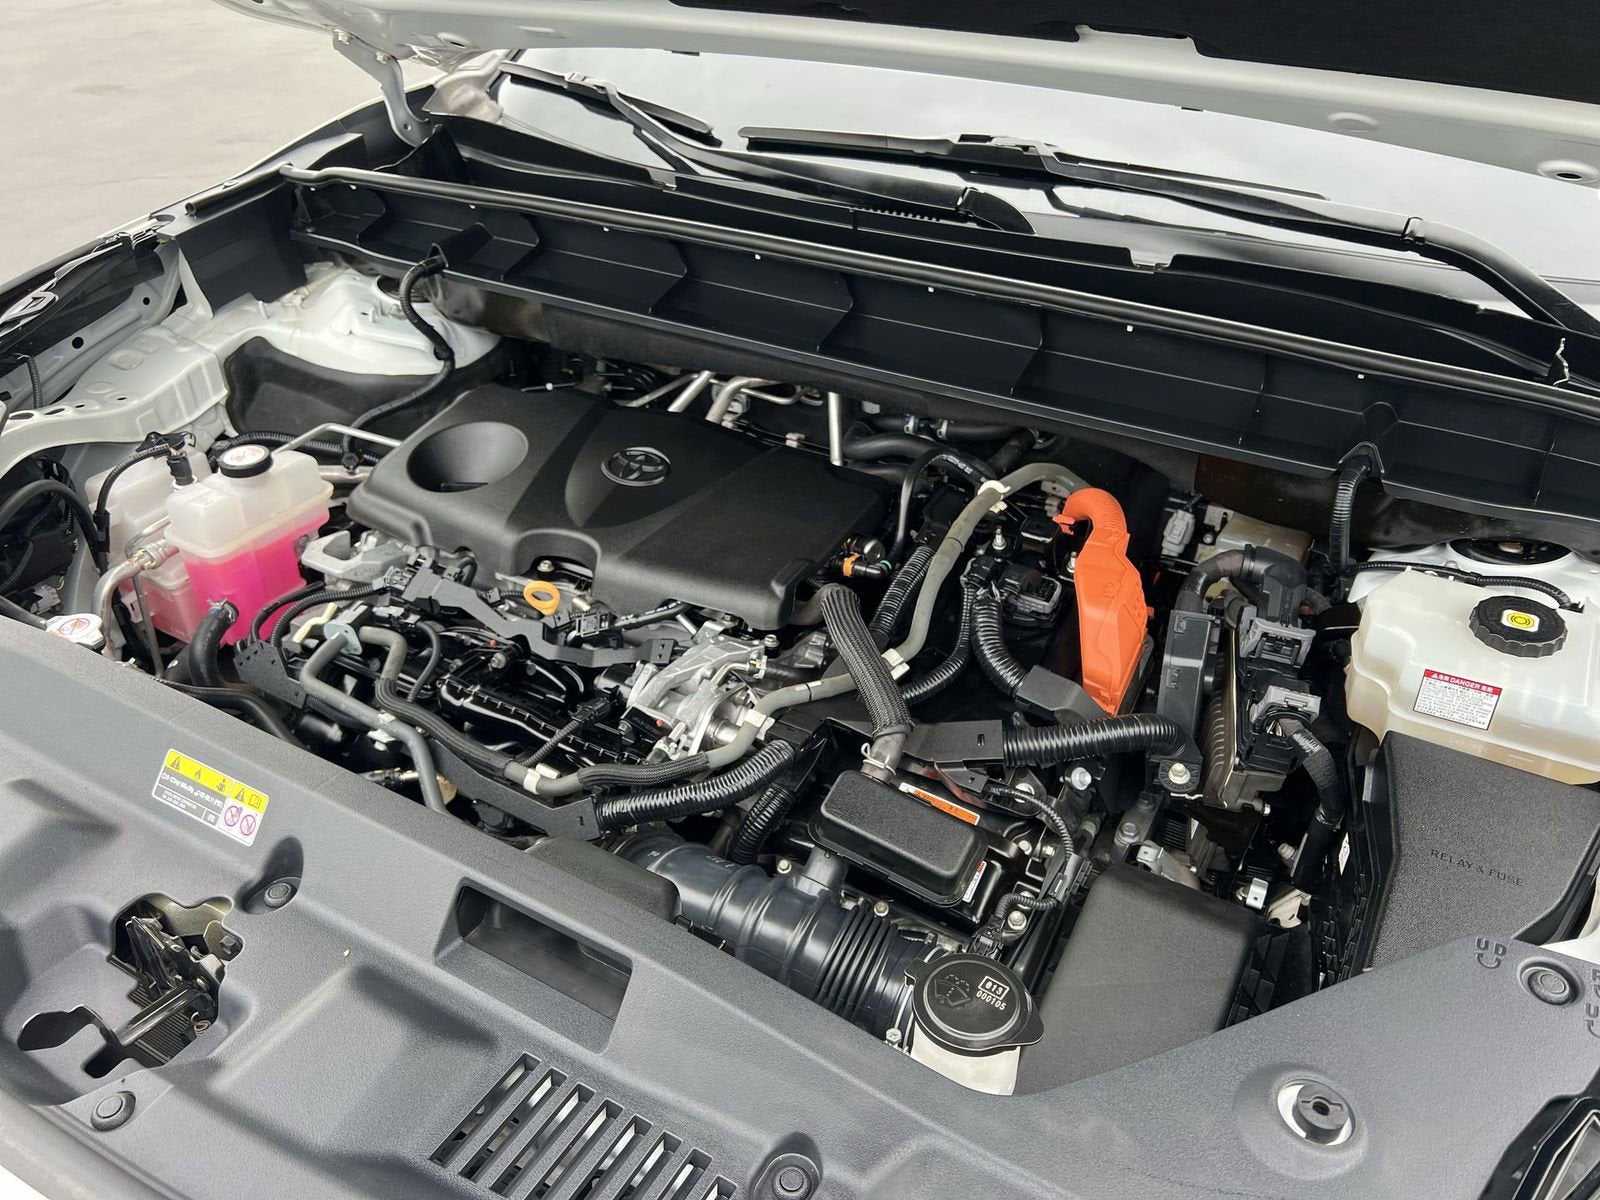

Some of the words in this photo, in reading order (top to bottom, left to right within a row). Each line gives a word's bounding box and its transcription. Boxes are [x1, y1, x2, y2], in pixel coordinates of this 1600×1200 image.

[1450, 677, 1480, 690] DANGER
[1430, 849, 1474, 869] RELAY
[1488, 868, 1523, 887] FUSE
[1477, 937, 1489, 951] U
[1494, 942, 1507, 957] D
[976, 990, 1007, 1011] 000105
